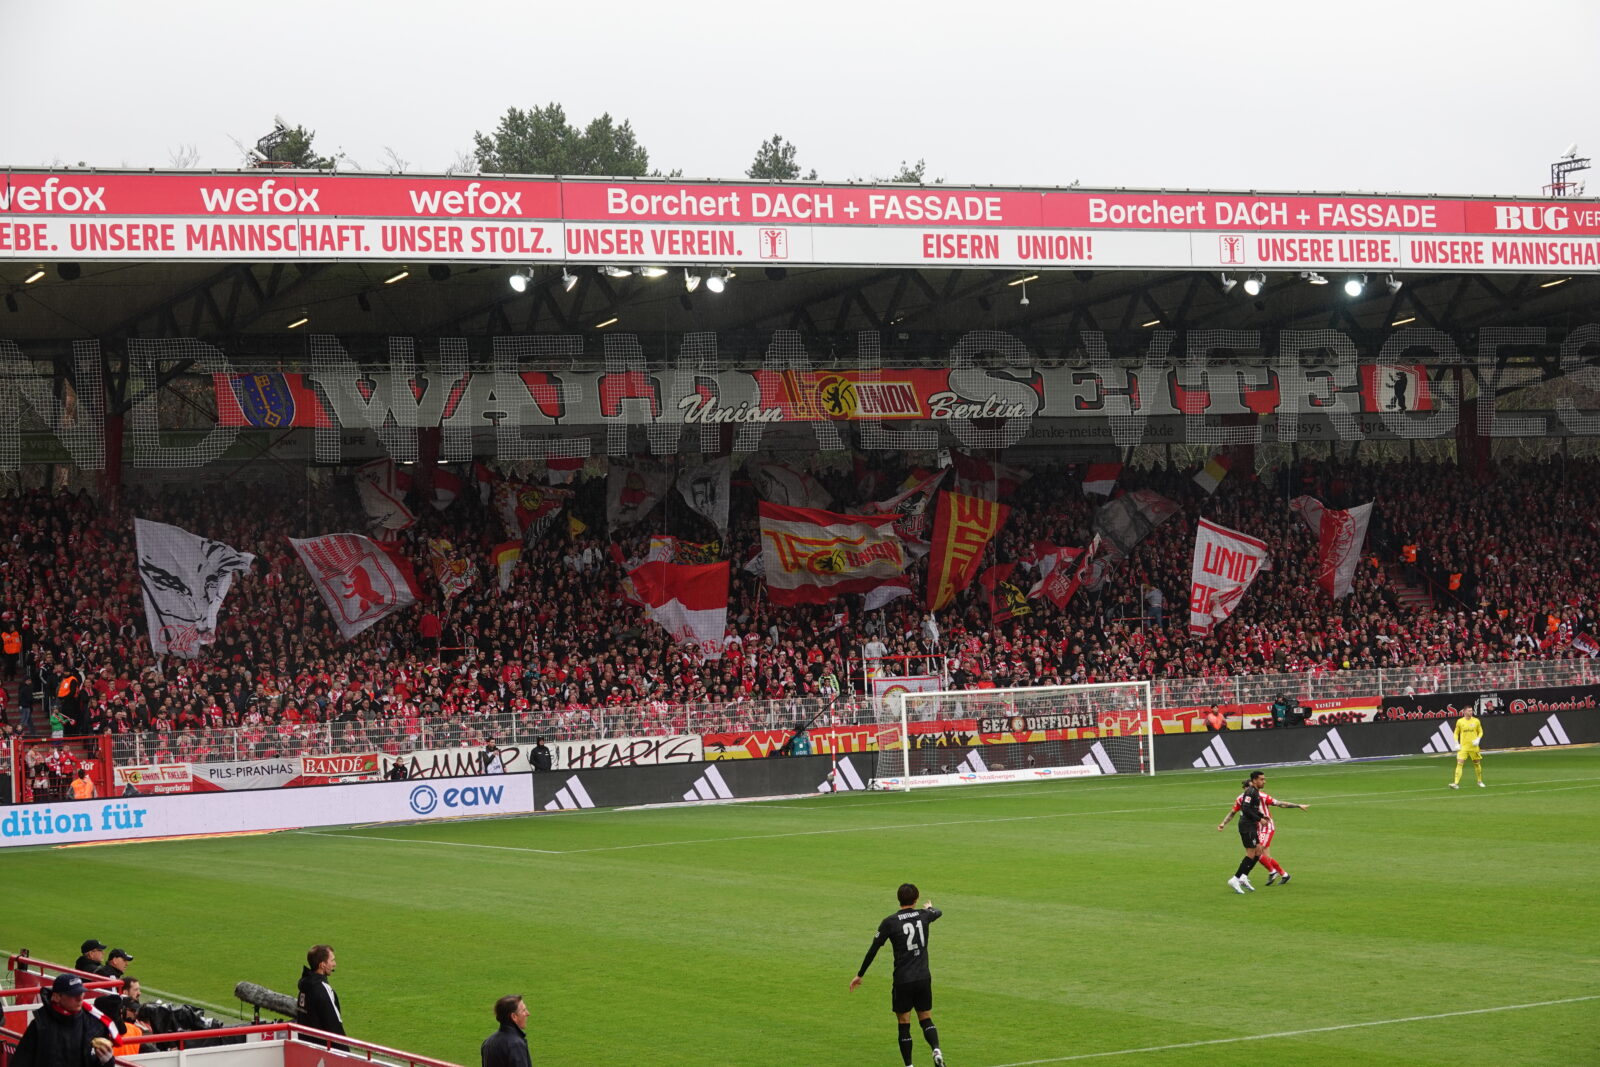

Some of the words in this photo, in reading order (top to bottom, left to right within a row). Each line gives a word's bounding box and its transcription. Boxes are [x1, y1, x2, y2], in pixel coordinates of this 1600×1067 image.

[0, 177, 106, 211] wefox
[200, 180, 320, 212] wefox
[409, 183, 522, 215] wefox
[607, 187, 740, 217] Borchert
[751, 192, 834, 219] DACH
[843, 201, 860, 219] +
[868, 194, 1003, 221] FASSADE
[1088, 197, 1207, 226] Borchert
[1215, 201, 1288, 226] DACH
[1295, 209, 1311, 226] +
[1318, 203, 1437, 228] FASSADE
[1494, 206, 1569, 231] BUG
[70, 223, 175, 251] UNSERE
[186, 223, 371, 252] MANNSCHAFT.
[381, 225, 464, 253] UNSER
[470, 226, 553, 254] STOLZ.
[566, 228, 645, 255] UNSER
[650, 228, 743, 257] VEREIN.
[922, 233, 1000, 259] EISERN
[1017, 235, 1093, 260] UNION!
[1257, 238, 1334, 263] UNSERE
[1338, 238, 1399, 263] LIEBE.
[1410, 240, 1485, 265] UNSERE
[1492, 241, 1600, 265] MANNSCHA
[679, 393, 784, 424] Union
[855, 385, 919, 413] UNION
[928, 392, 1027, 419] Berlin
[443, 784, 504, 808] eaw
[1, 808, 93, 838] dition
[101, 803, 147, 831] für
[902, 920, 925, 951] 21
